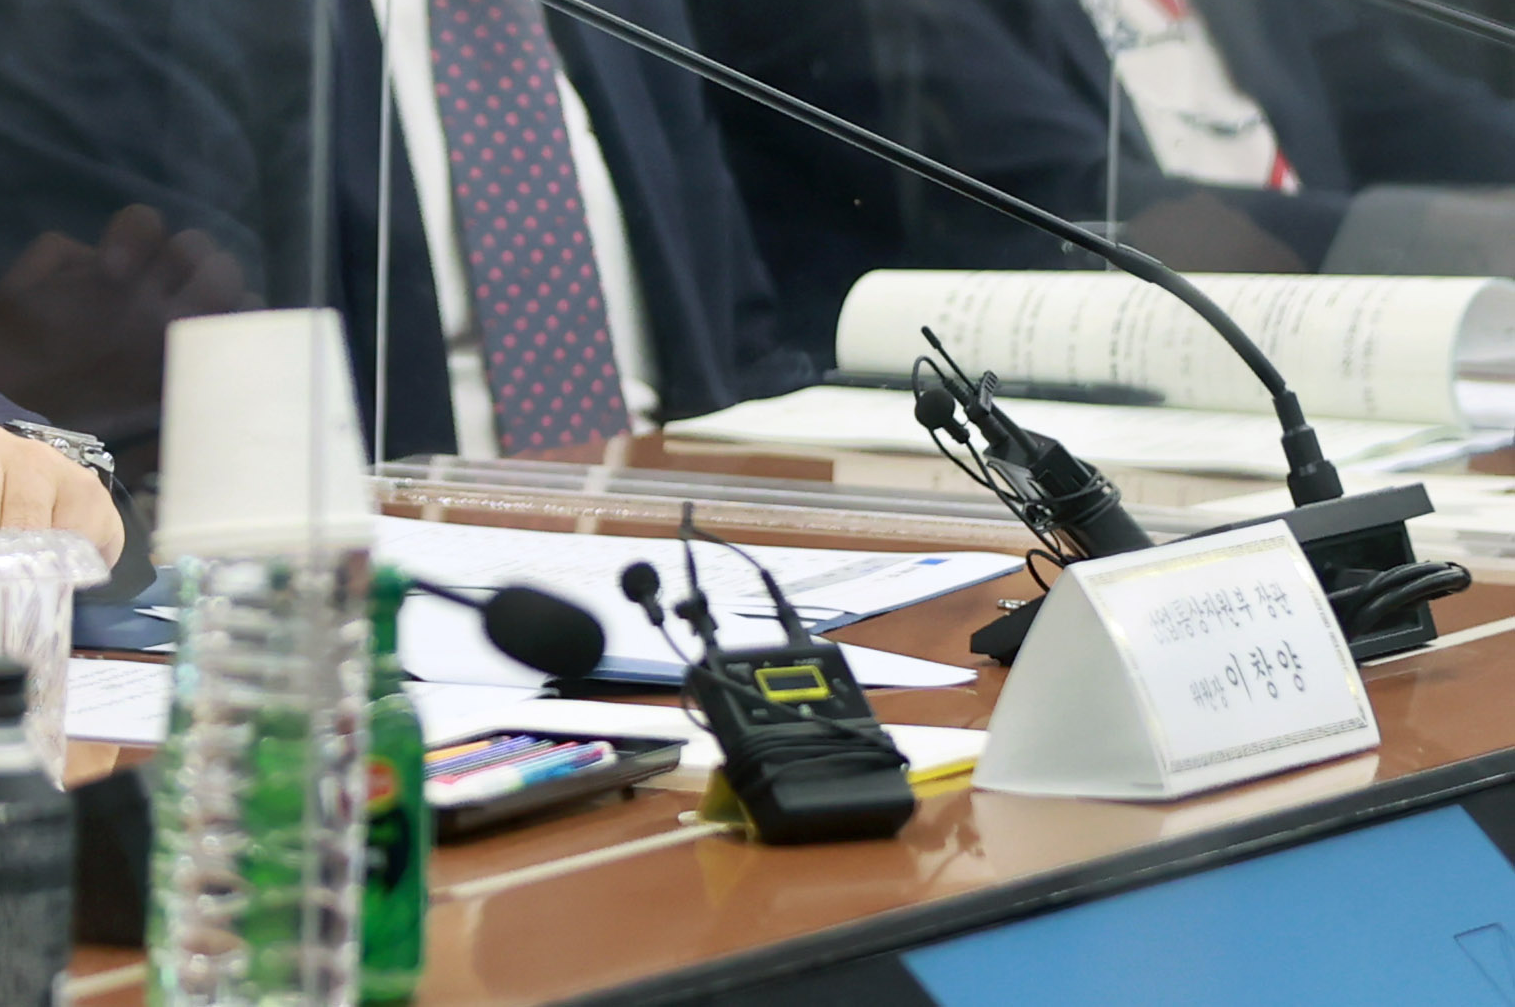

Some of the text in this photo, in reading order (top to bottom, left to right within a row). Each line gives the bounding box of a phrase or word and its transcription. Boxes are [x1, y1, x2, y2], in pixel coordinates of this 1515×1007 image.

[1254, 580, 1292, 617] 장관
[1190, 640, 1305, 711] 위원장 이창양
